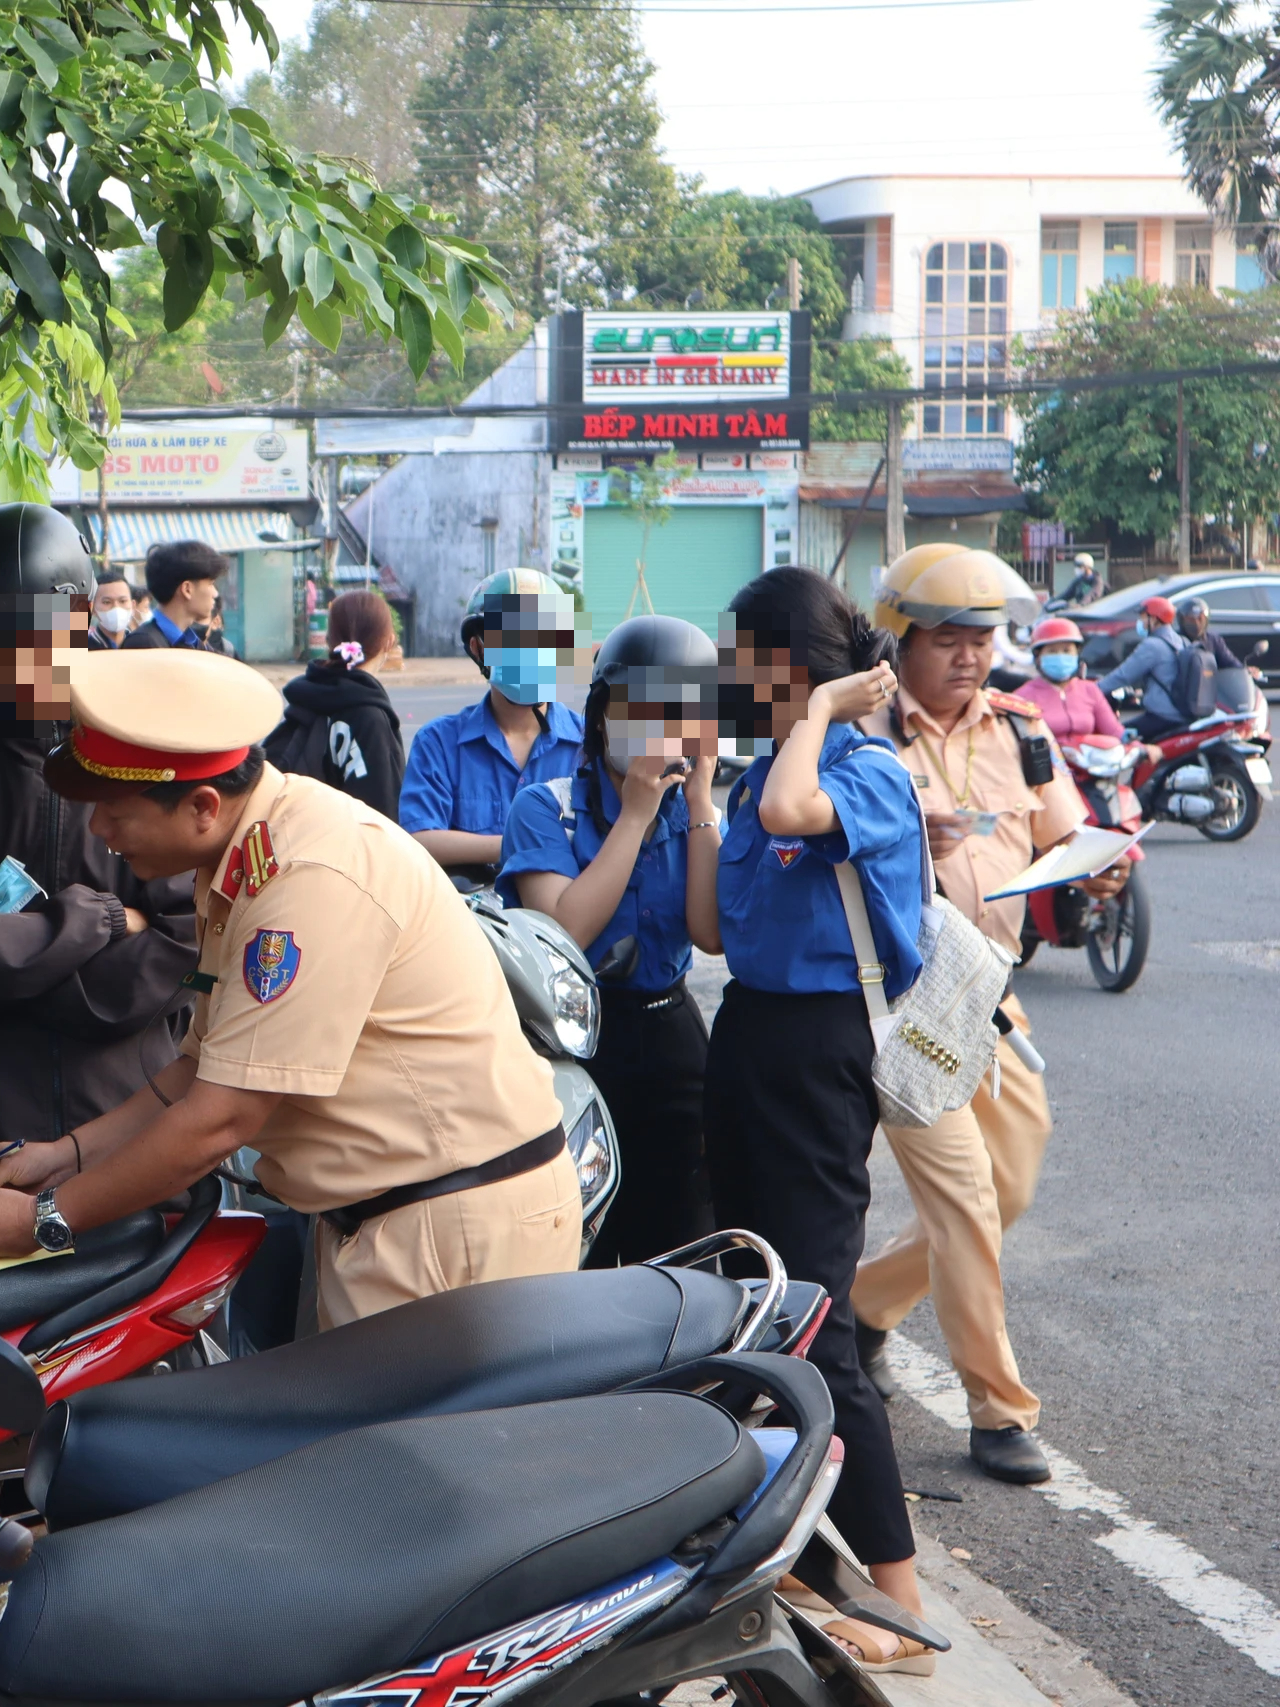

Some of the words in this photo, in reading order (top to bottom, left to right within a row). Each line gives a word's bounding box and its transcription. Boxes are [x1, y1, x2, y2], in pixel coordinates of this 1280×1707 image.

[592, 368, 649, 385] MADE
[656, 368, 676, 385] IN
[683, 367, 779, 385] GERMANY
[583, 407, 636, 438] BẾP
[643, 414, 719, 437] MINH
[725, 409, 788, 437] TÂM
[151, 437, 159, 447] &
[214, 436, 228, 447] XE
[140, 454, 220, 474] MOTO
[248, 966, 290, 980] CSGT
